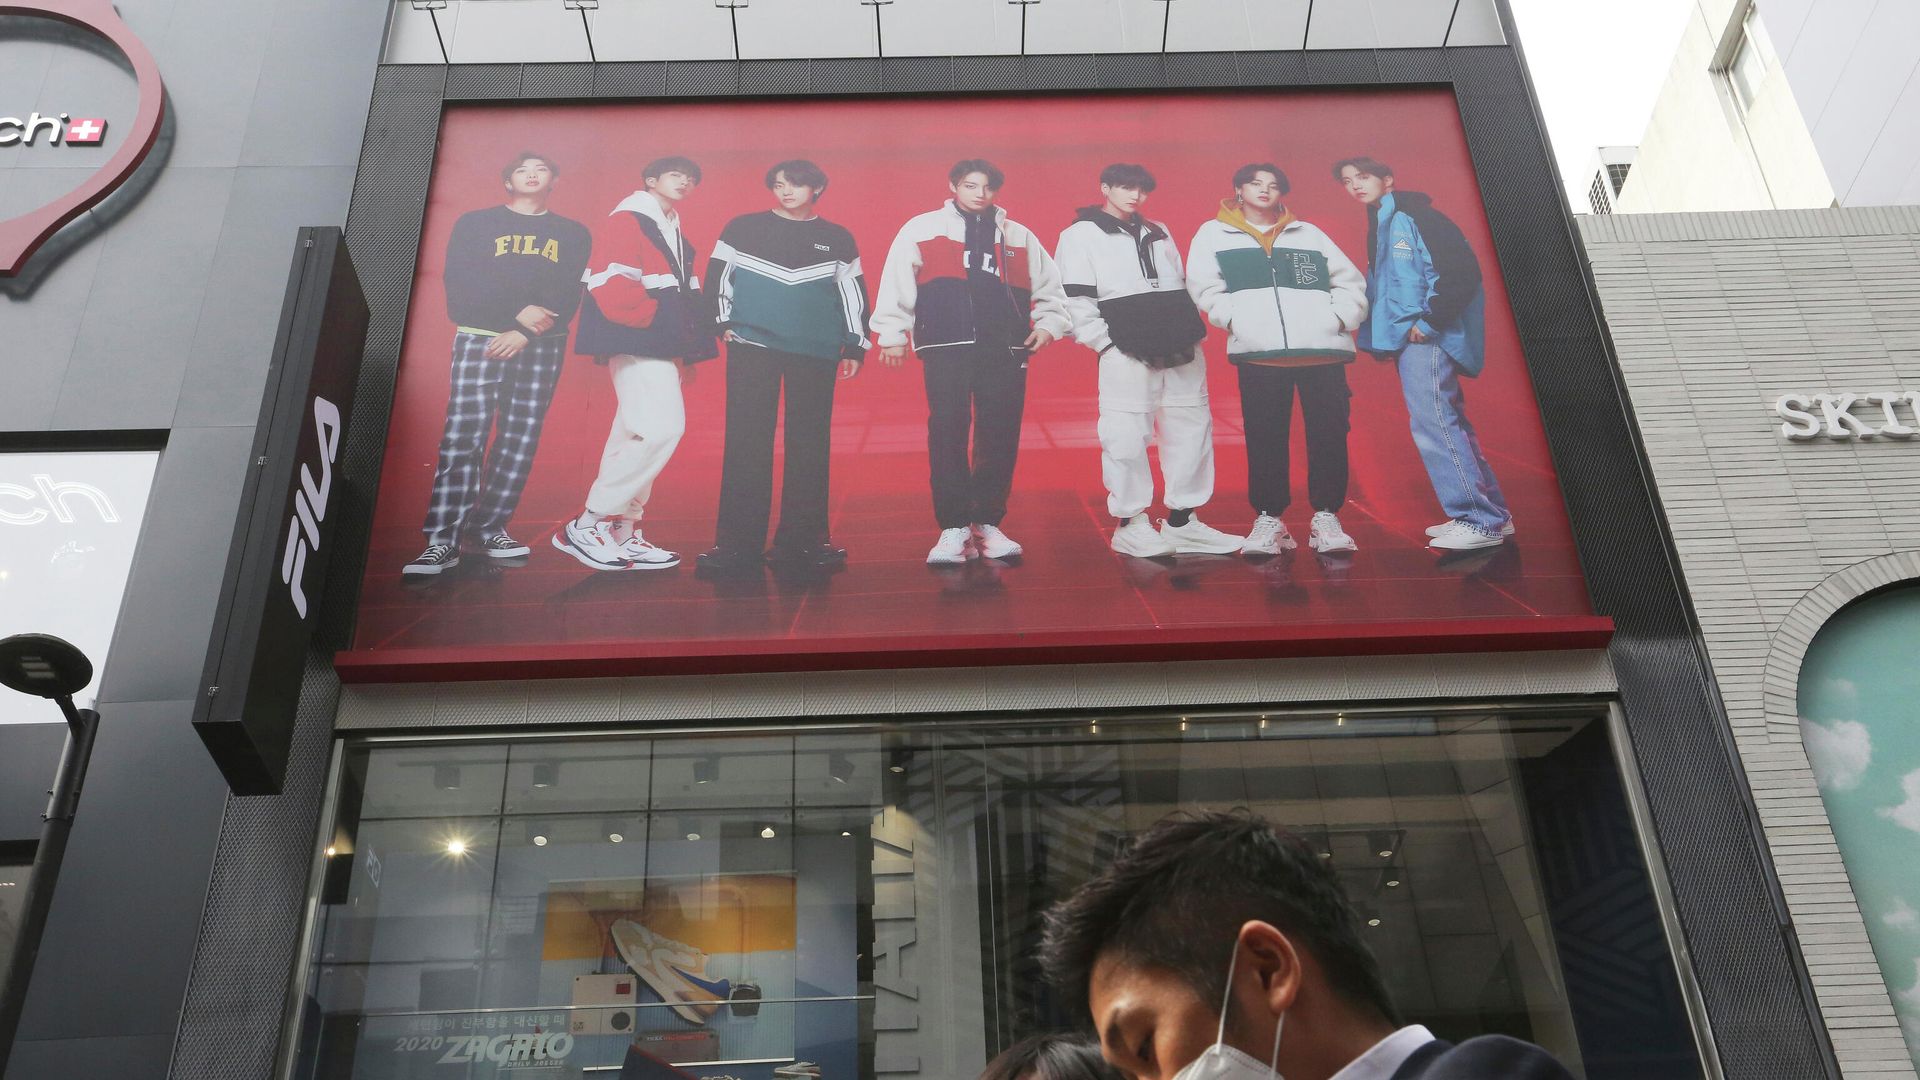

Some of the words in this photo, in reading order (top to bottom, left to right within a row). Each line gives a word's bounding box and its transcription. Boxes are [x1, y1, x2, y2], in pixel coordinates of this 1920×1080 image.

[494, 234, 560, 263] FILA
[282, 395, 341, 620] FILA
[394, 1036, 443, 1052] 2020
